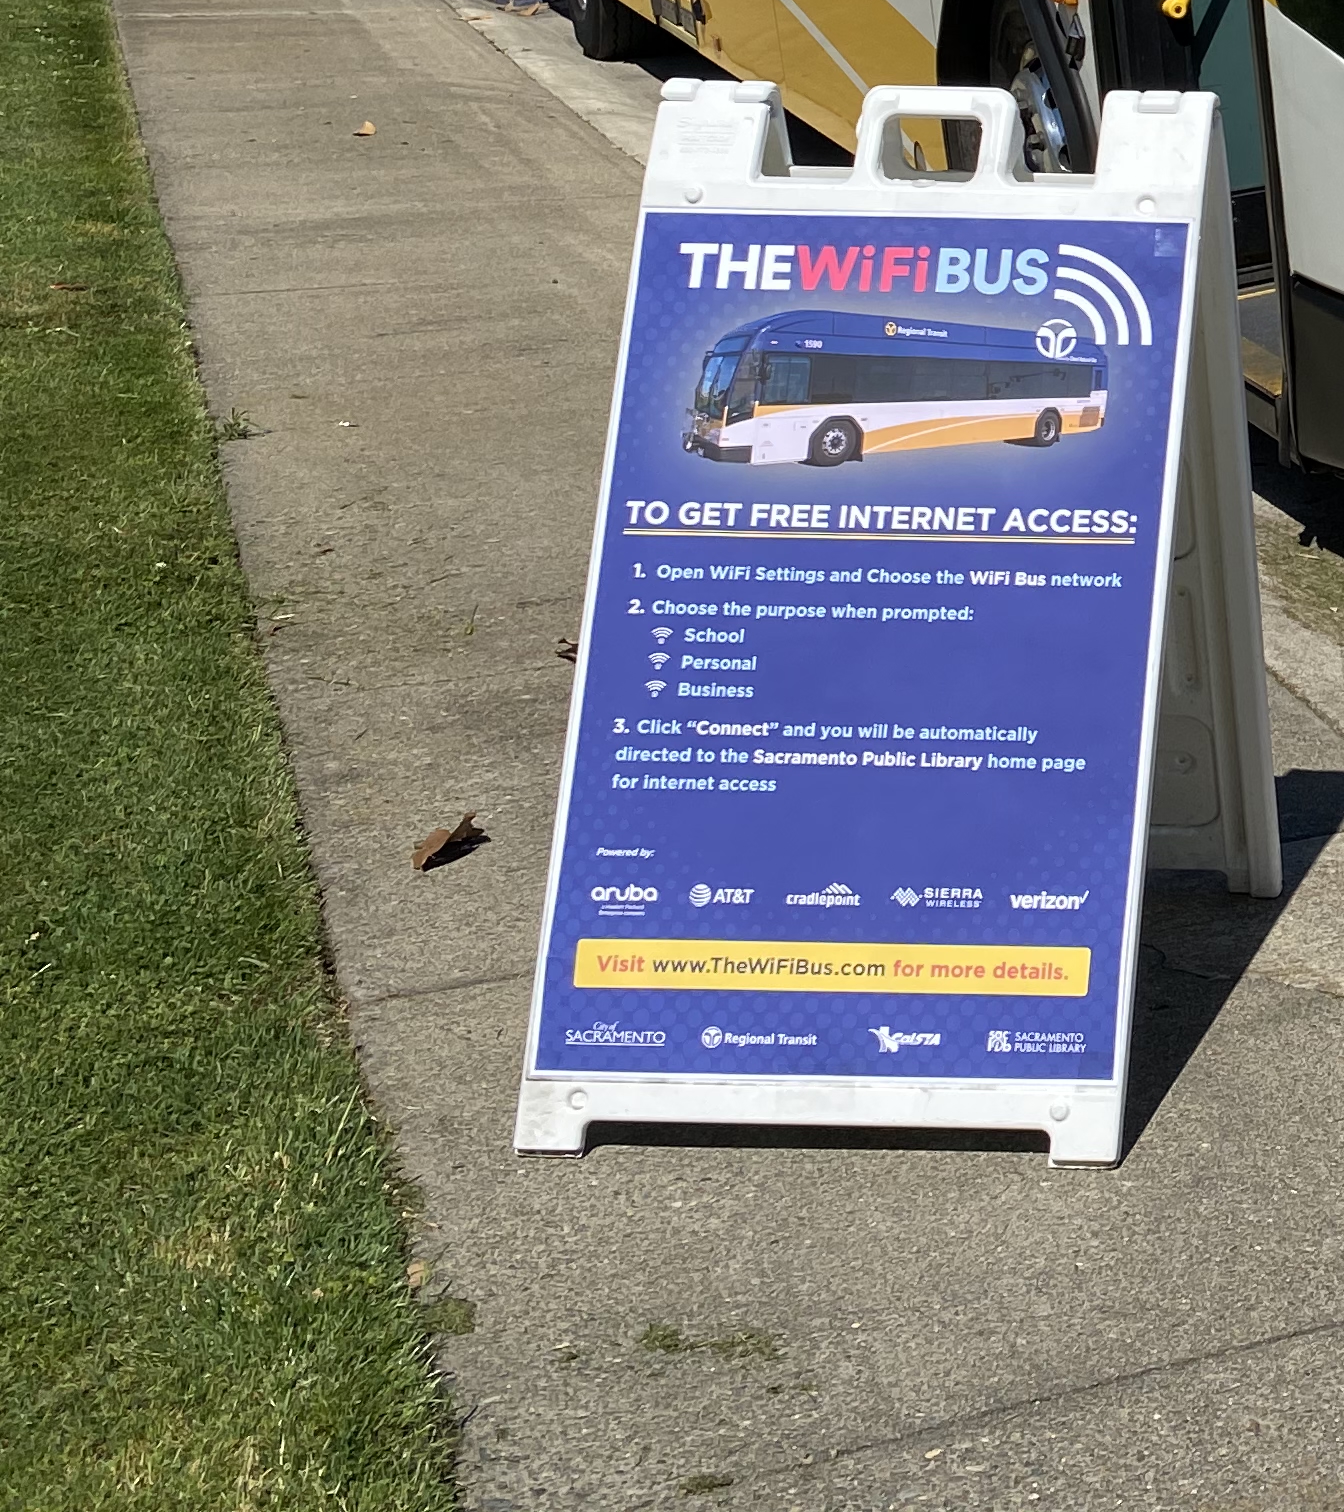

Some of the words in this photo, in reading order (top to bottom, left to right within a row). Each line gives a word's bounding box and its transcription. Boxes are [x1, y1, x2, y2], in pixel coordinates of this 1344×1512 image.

[625, 500, 670, 525] TO
[678, 501, 743, 527] GET
[750, 503, 831, 529] FREE
[838, 505, 996, 532] INTERNET
[1002, 507, 1138, 534] ACCESS:
[632, 562, 647, 579] 1.
[656, 564, 704, 582] Open
[709, 565, 751, 580] WiFi
[755, 566, 825, 584] Settings
[829, 567, 862, 583] and
[866, 568, 931, 584] Choose
[935, 570, 964, 585] the
[969, 570, 1011, 586] WiFi
[1014, 571, 1047, 587] Bus
[1050, 572, 1123, 588] network
[626, 598, 645, 615] 2.
[651, 600, 719, 616] Choose
[722, 601, 751, 616] the
[755, 604, 827, 620] purpose
[831, 603, 877, 619] when
[881, 605, 975, 622] prompted:
[683, 627, 746, 644] School
[680, 654, 758, 671] Personal
[677, 682, 755, 698] Business
[612, 718, 631, 735] 3.
[636, 719, 683, 735] Click
[686, 720, 779, 737] “Connect”
[782, 722, 816, 738] and
[819, 724, 853, 741] you
[857, 723, 889, 739] will
[892, 724, 916, 740] be
[918, 725, 1039, 745] automatically
[615, 746, 693, 763] directed
[696, 748, 716, 764] to
[719, 748, 749, 764] the
[752, 749, 858, 766] Sacramento
[861, 750, 917, 768] Public
[920, 751, 983, 771] Library
[987, 753, 1037, 770] home
[1041, 756, 1087, 773] page
[611, 773, 639, 790] for
[642, 774, 715, 791] internet
[718, 777, 777, 792] access
[596, 847, 639, 858] Powered
[590, 883, 658, 902] aruba
[712, 887, 755, 904] AT&T
[785, 890, 861, 909] cradlepoint
[923, 887, 983, 900] SIERRA
[1009, 890, 1080, 911] verizon
[925, 899, 982, 908] WIRELESS
[596, 954, 646, 974] Visit
[652, 957, 886, 977] www.TheWiFiBus.com
[892, 959, 924, 978] for
[930, 963, 986, 979] more
[992, 961, 1069, 981] details.
[565, 1029, 666, 1044] SACRAMENTO
[723, 1032, 775, 1047] Regional
[777, 1033, 818, 1046] Transit
[1014, 1031, 1085, 1043] SACRAMENTO
[1013, 1042, 1046, 1053] PUBLIC
[1048, 1043, 1088, 1054] LIBRARY
